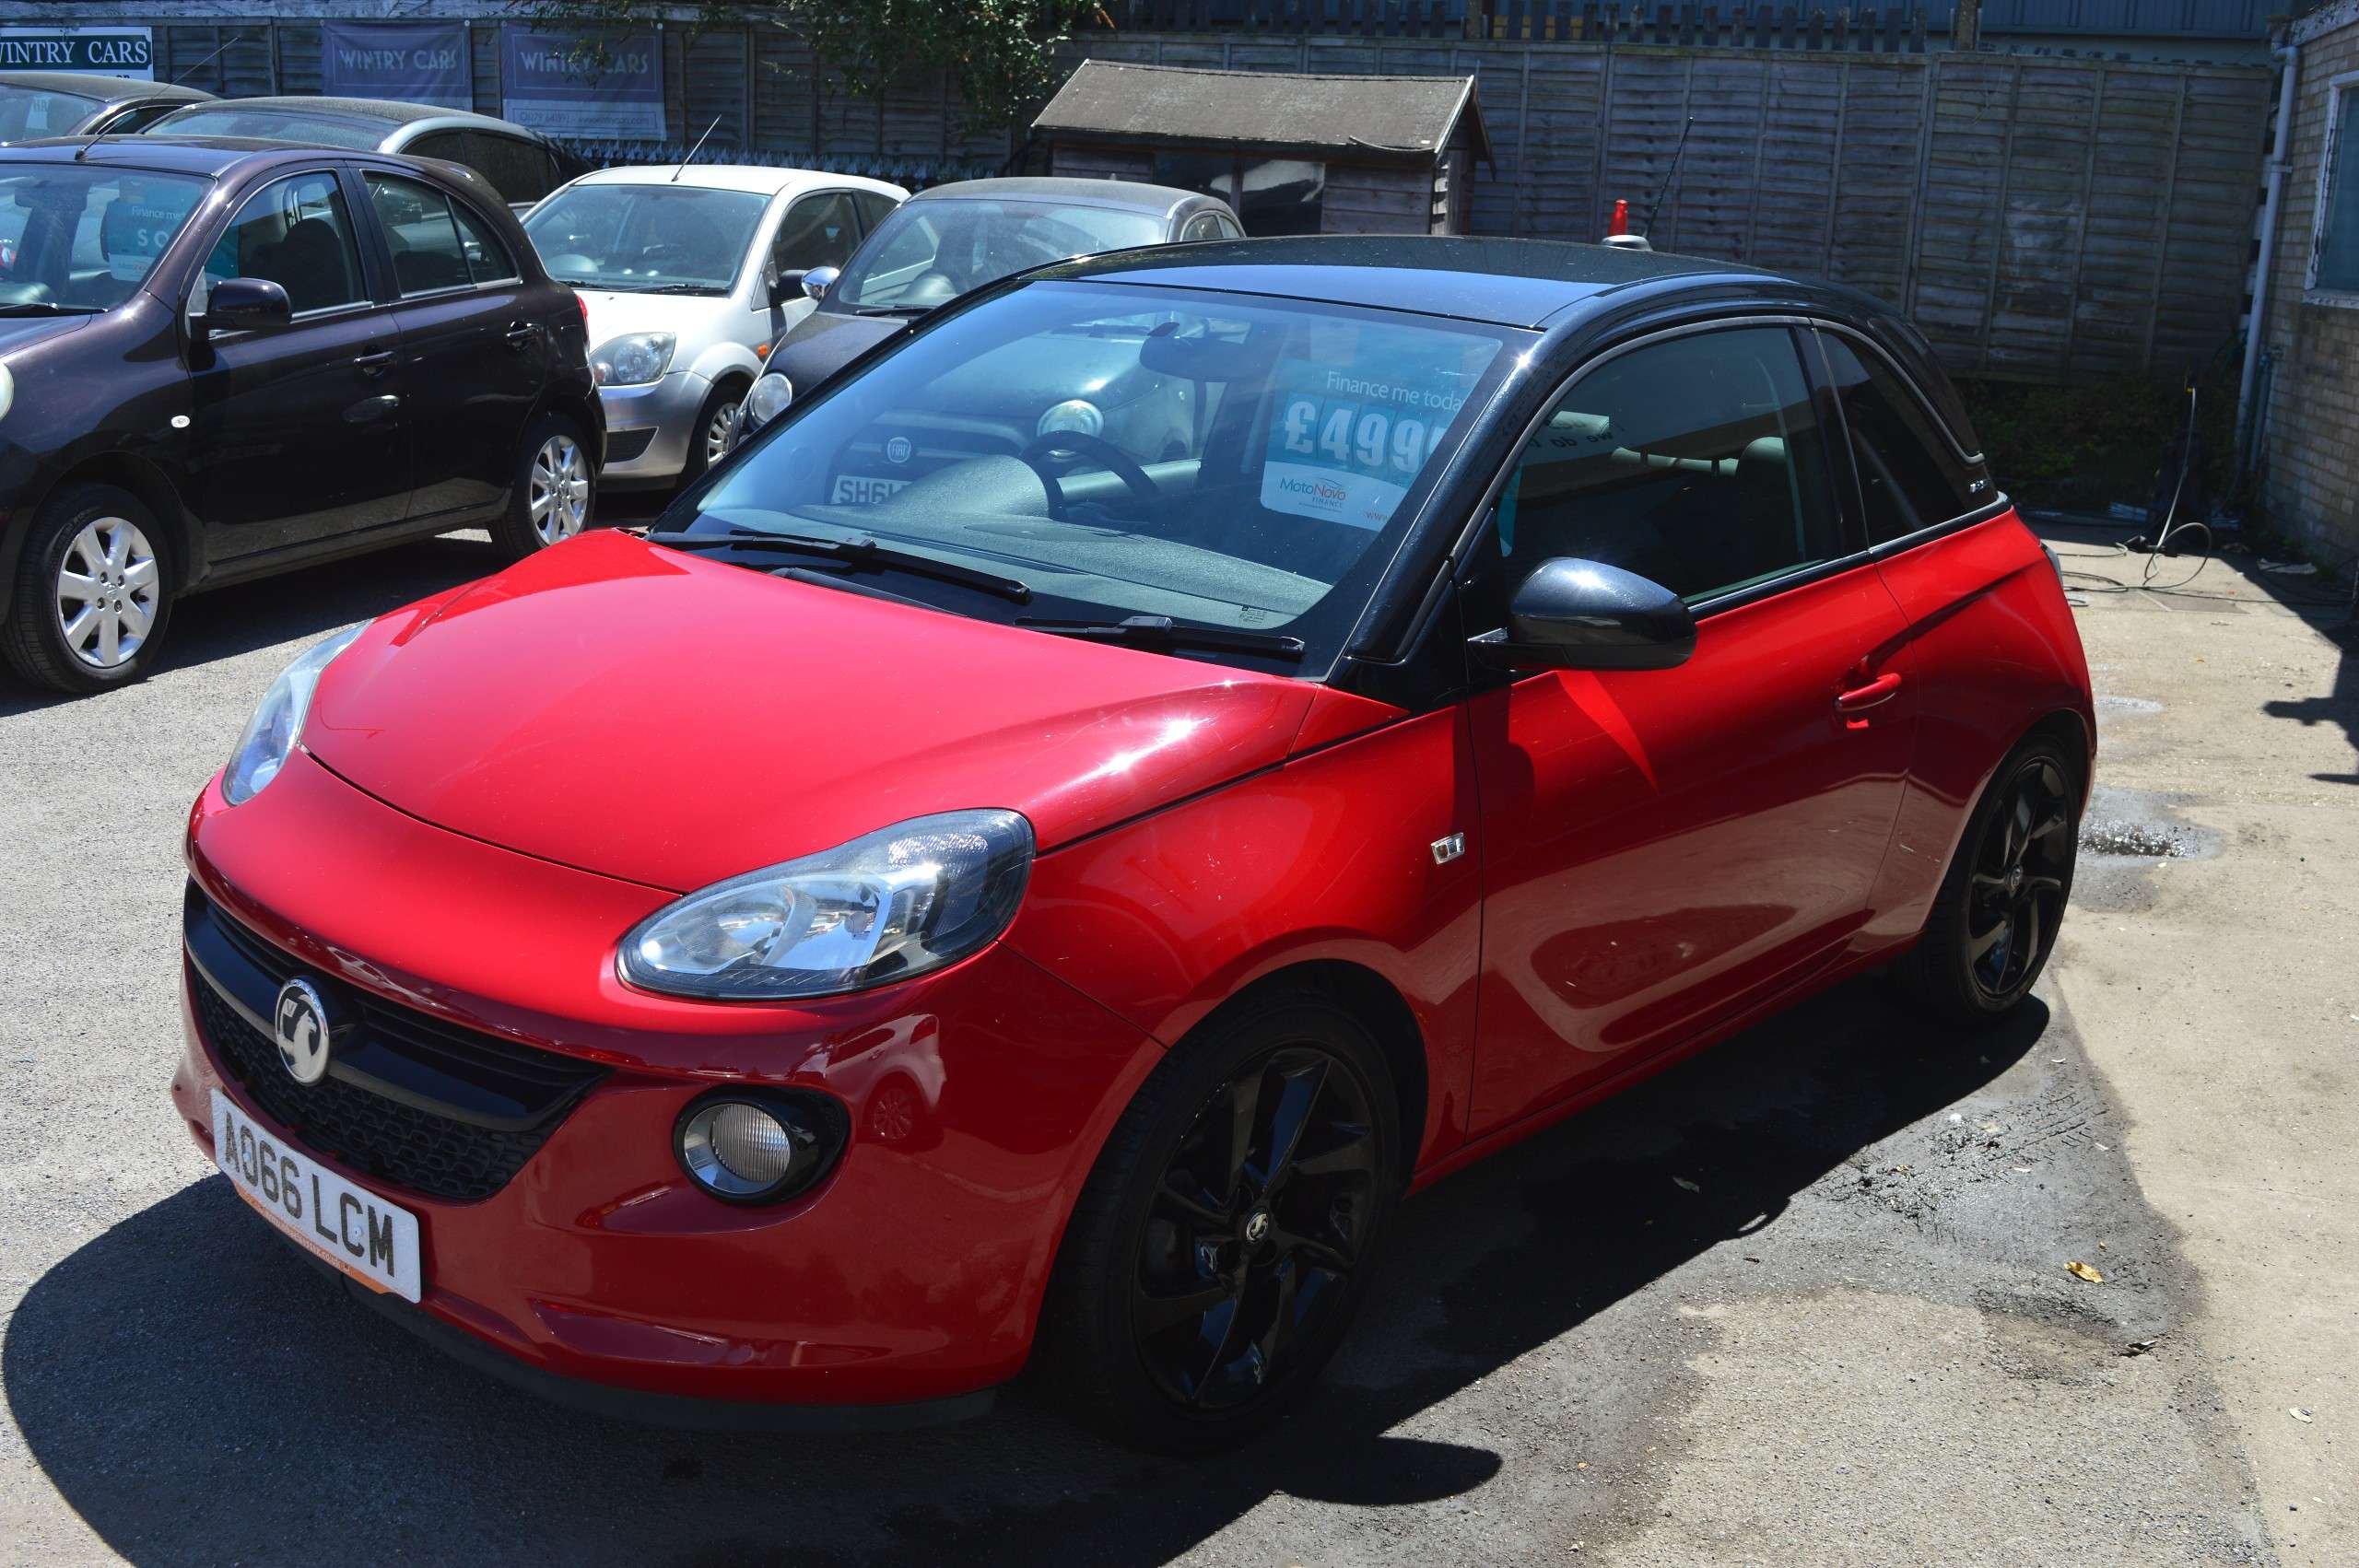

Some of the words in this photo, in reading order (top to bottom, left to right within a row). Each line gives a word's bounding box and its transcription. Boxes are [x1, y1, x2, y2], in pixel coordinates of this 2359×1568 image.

[88, 41, 148, 64] CARS
[339, 50, 405, 71] WINTRY
[414, 50, 457, 70] CARS
[1327, 370, 1389, 398] Finance
[1391, 387, 1419, 404] me
[1423, 391, 1467, 412] toda
[1279, 477, 1346, 501] MotoNovo
[225, 1111, 302, 1220] AO66
[311, 1172, 395, 1278] LCM
